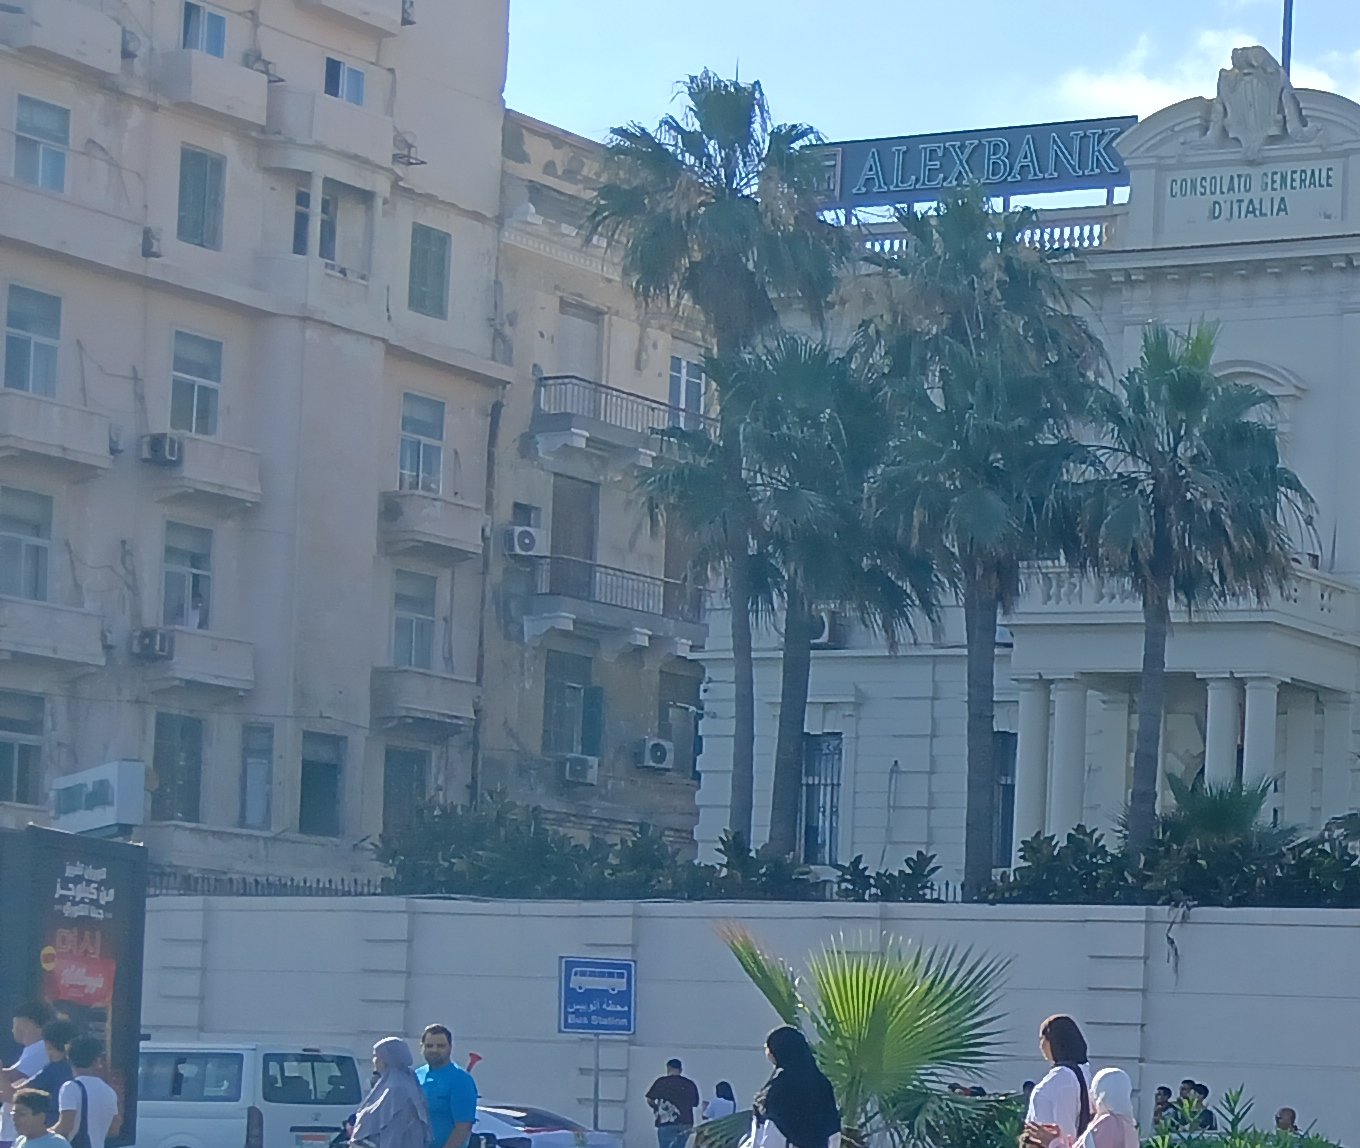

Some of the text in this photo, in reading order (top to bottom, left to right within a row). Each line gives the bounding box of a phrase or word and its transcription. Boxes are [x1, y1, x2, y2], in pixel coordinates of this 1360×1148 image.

[852, 127, 1120, 194] ALEXBANK
[1170, 167, 1333, 198] CONSOLATO GENERALE
[1212, 196, 1289, 220] D'ITALIA
[567, 1014, 628, 1026] Bus Station
